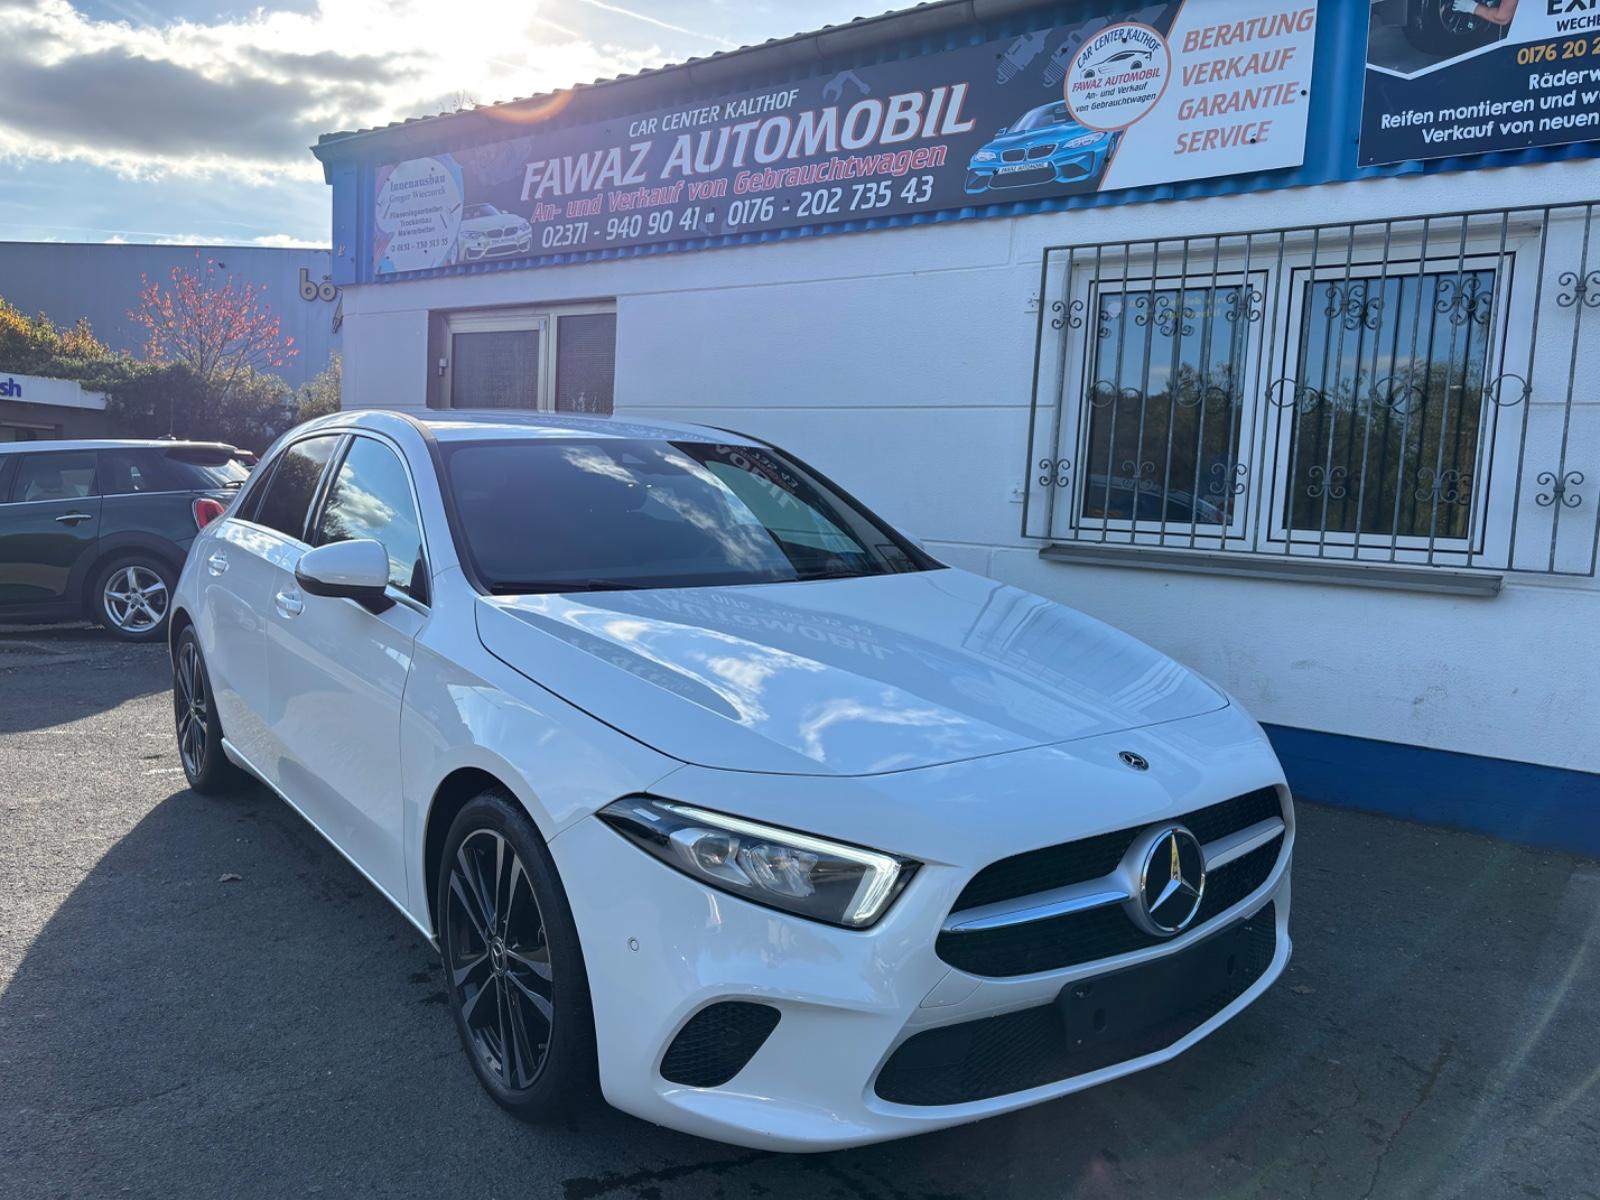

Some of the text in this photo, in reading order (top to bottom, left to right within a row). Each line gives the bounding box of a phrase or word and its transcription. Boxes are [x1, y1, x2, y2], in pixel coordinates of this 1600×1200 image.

[1077, 28, 1161, 69] CAR CENTER KALTHOF
[1182, 8, 1315, 54] BERATUNG
[1182, 47, 1296, 87] VERKAUF
[1517, 43, 1557, 65] 0176
[1562, 39, 1587, 59] 20
[1072, 67, 1160, 92] FAWAZ AUTOMOBIL
[1085, 82, 1148, 100] An- und Verkauf
[629, 89, 799, 138] CAR CENTER KALTHOF
[1075, 93, 1157, 112] von Gebrauchtwagen
[1177, 82, 1299, 121] GARANTIE
[1381, 110, 1434, 130] Reifen
[1438, 99, 1535, 122] montieren
[1540, 89, 1577, 110] und
[520, 82, 976, 201] FAWAZ AUTOMOBIL
[1174, 120, 1272, 155] SERVICE
[1422, 112, 1600, 144] Verkauf von neuen
[531, 145, 948, 223] An- und Verkauf von Gebrauchtwagen
[542, 222, 589, 249] 02371
[606, 214, 642, 241] 940
[648, 210, 673, 235] 90
[679, 206, 700, 232] 41
[727, 196, 775, 226] 0176
[797, 187, 842, 217] 202
[850, 180, 892, 212] 735
[901, 175, 934, 204] 43
